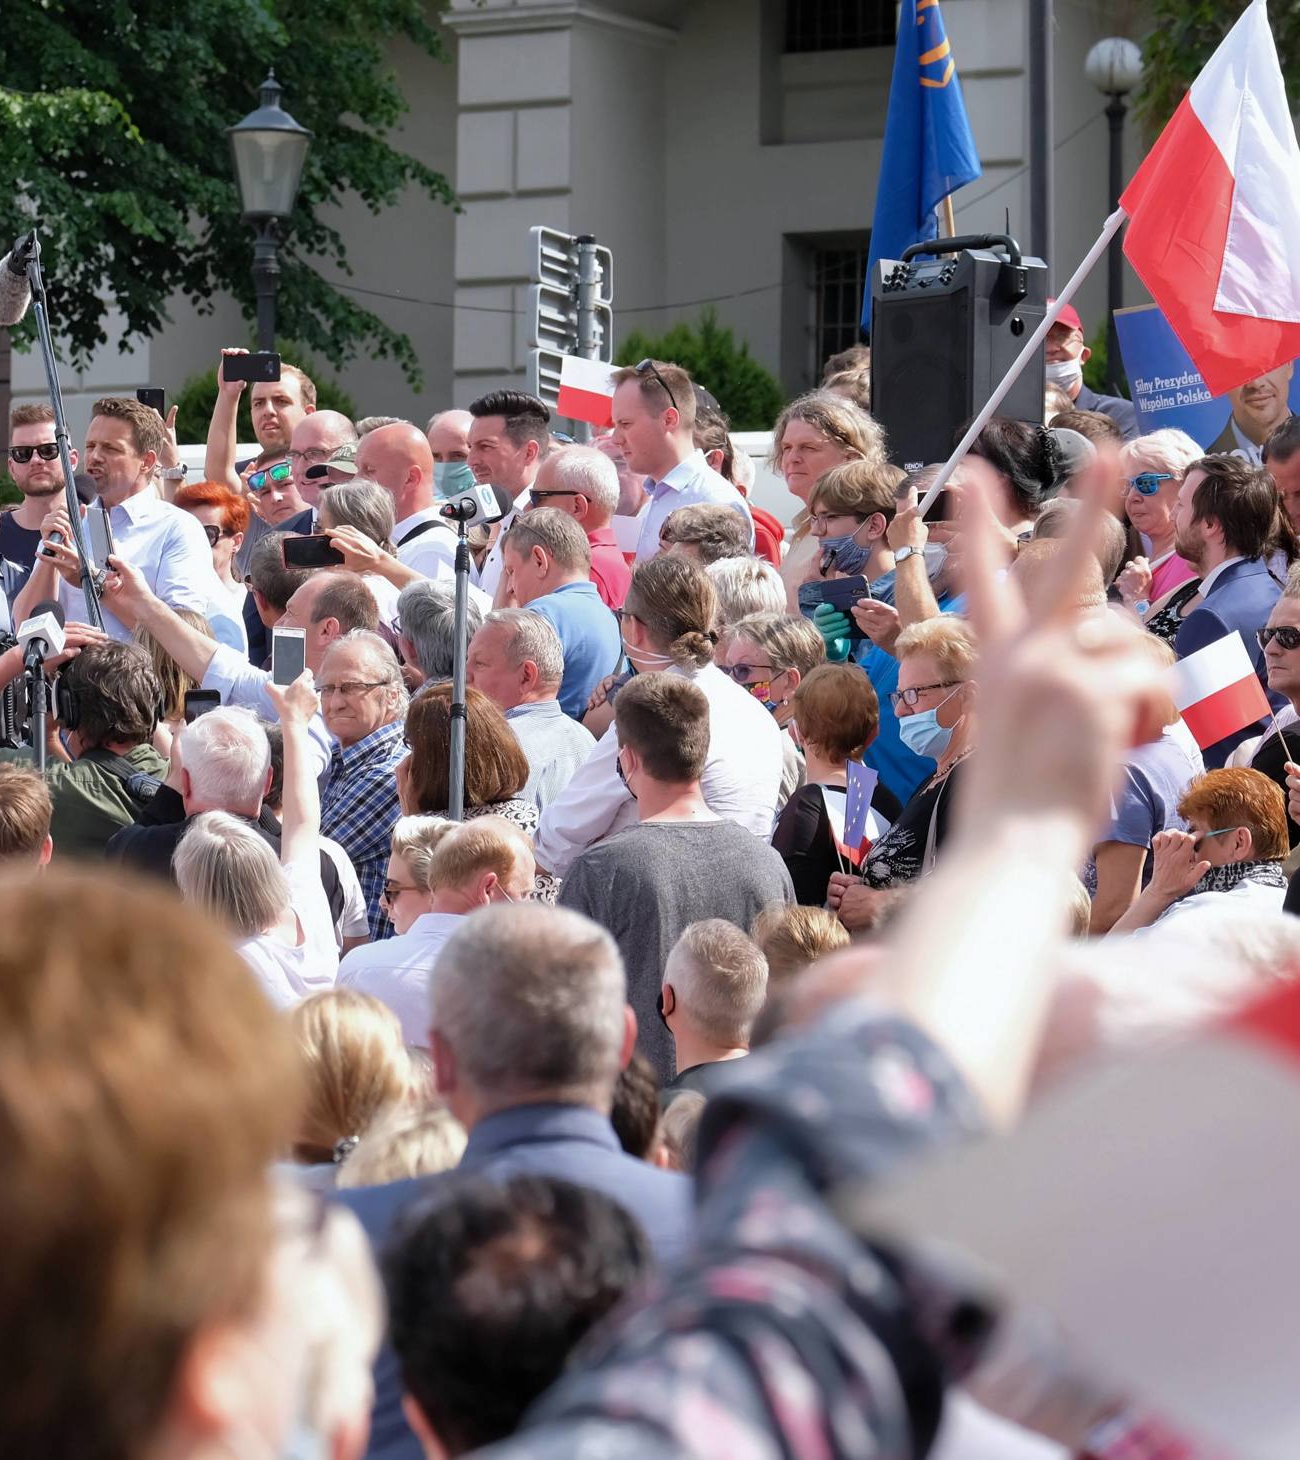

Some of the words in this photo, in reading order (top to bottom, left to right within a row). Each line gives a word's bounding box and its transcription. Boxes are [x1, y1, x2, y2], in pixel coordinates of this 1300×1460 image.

[1135, 378, 1153, 394] Silny
[1154, 371, 1203, 389] Prezyden
[1139, 394, 1175, 412] Wspólna
[1176, 388, 1211, 405] Polska
[904, 461, 924, 470] DENON
